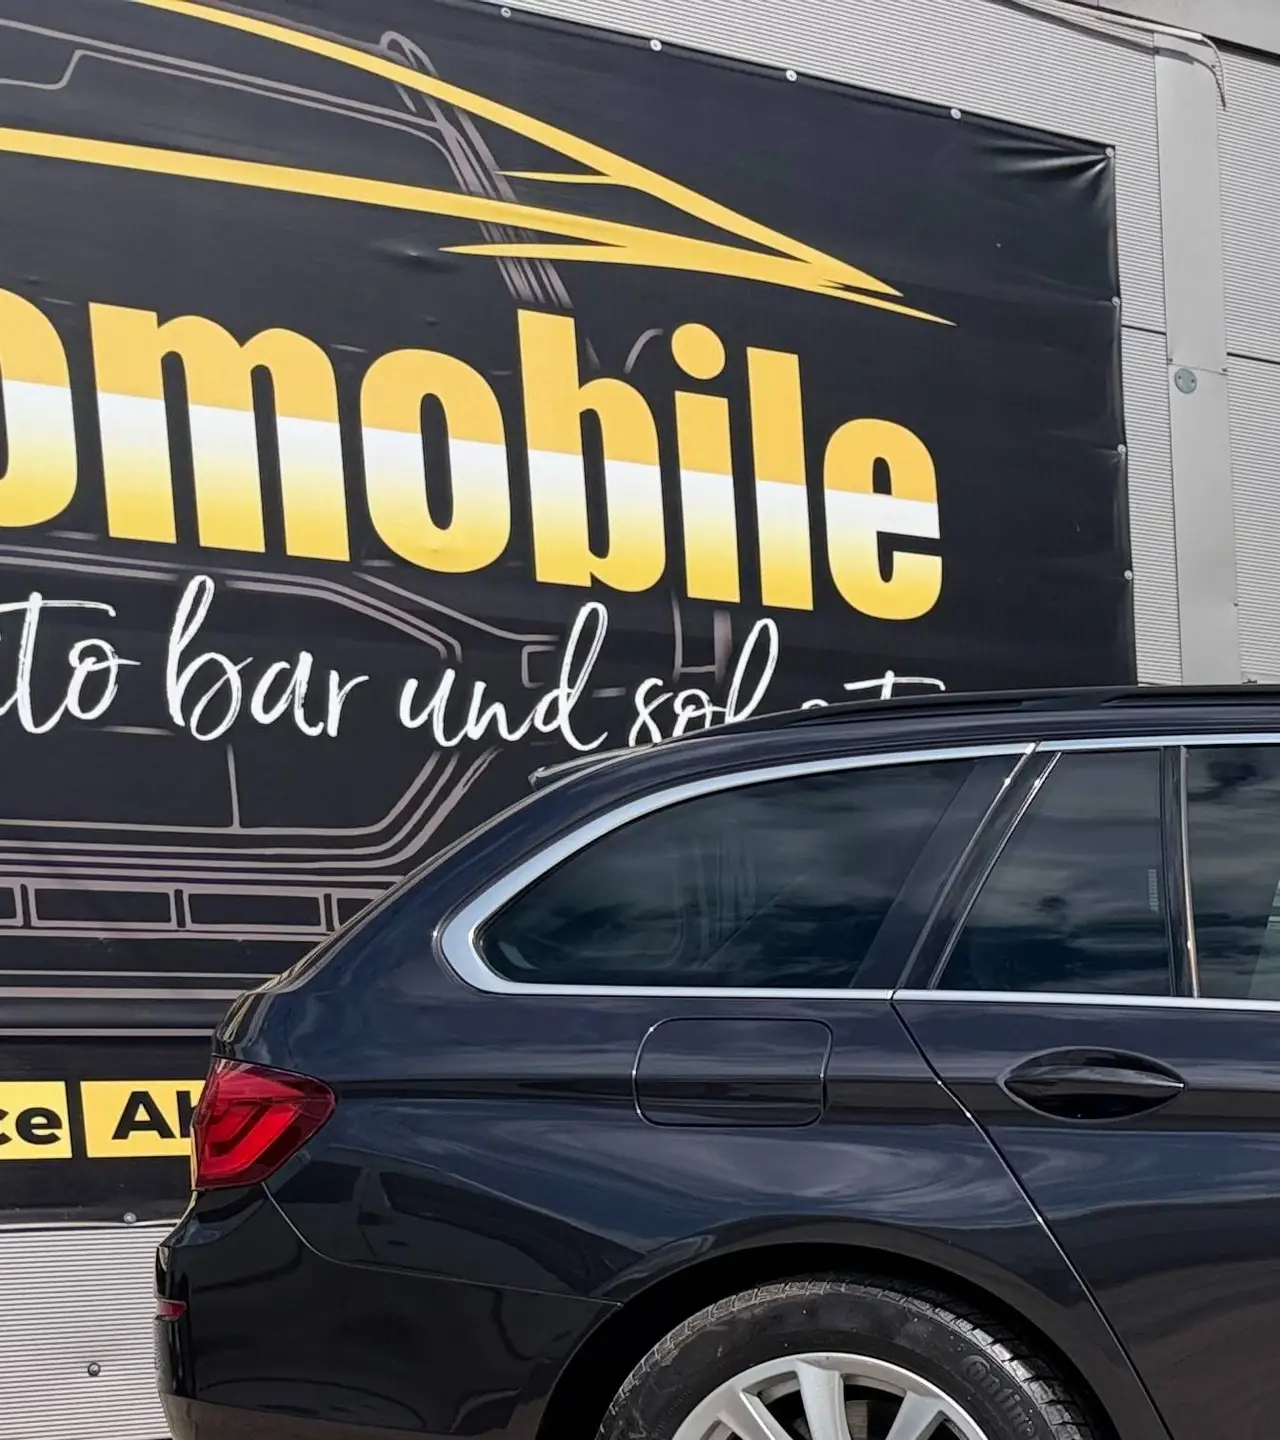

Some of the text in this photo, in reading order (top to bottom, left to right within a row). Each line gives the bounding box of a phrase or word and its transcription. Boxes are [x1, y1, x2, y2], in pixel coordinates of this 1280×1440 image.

[166, 575, 370, 741] bar
[399, 601, 609, 751] und
[0, 1107, 63, 1145] e
